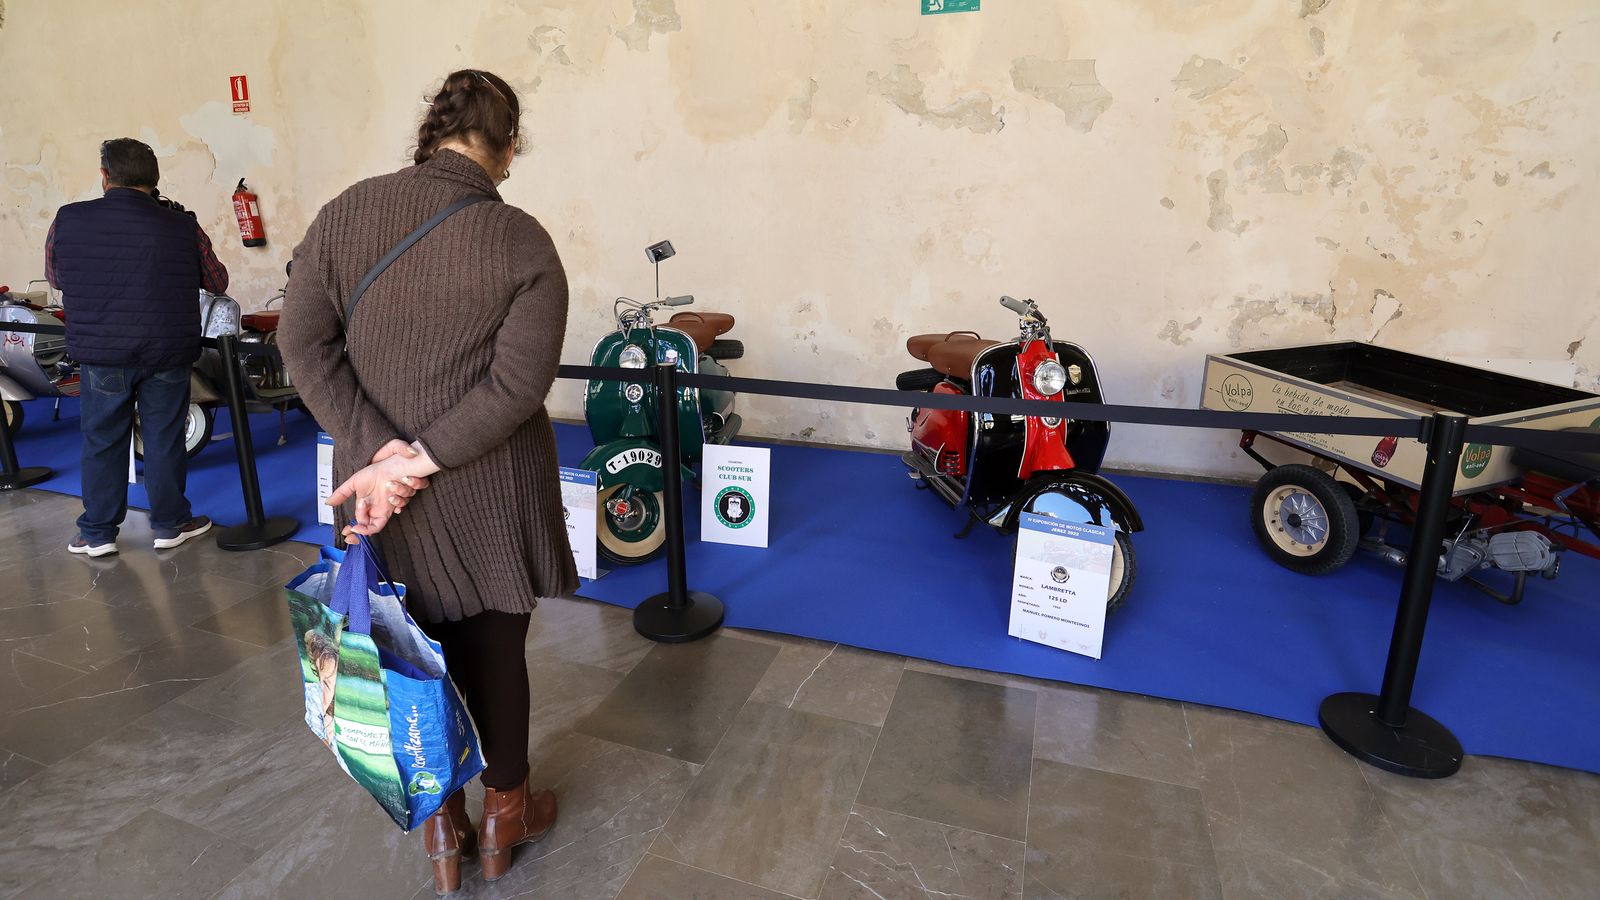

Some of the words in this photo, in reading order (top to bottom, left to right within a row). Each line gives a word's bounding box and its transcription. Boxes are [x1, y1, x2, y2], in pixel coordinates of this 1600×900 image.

[1225, 383, 1251, 398] Volpa
[1272, 383, 1281, 394] La
[1285, 387, 1310, 403] bebida
[1313, 397, 1324, 407] de
[1326, 405, 1351, 416] moda
[1276, 398, 1285, 406] en
[1288, 399, 1302, 411] los
[608, 450, 662, 471] T-19029
[1466, 446, 1491, 463] Volpa
[717, 465, 754, 473] SCOOTERS
[718, 473, 738, 481] CLUB
[1032, 518, 1059, 528] EXPOSICIÓN
[1082, 528, 1106, 537] CLASICAS
[1051, 527, 1067, 535] JEREZ
[1041, 583, 1076, 596] LAMBRETTA
[1022, 608, 1041, 617] MANUEL
[1041, 612, 1060, 622] ROMERO
[1060, 617, 1090, 629] MONTESINOS
